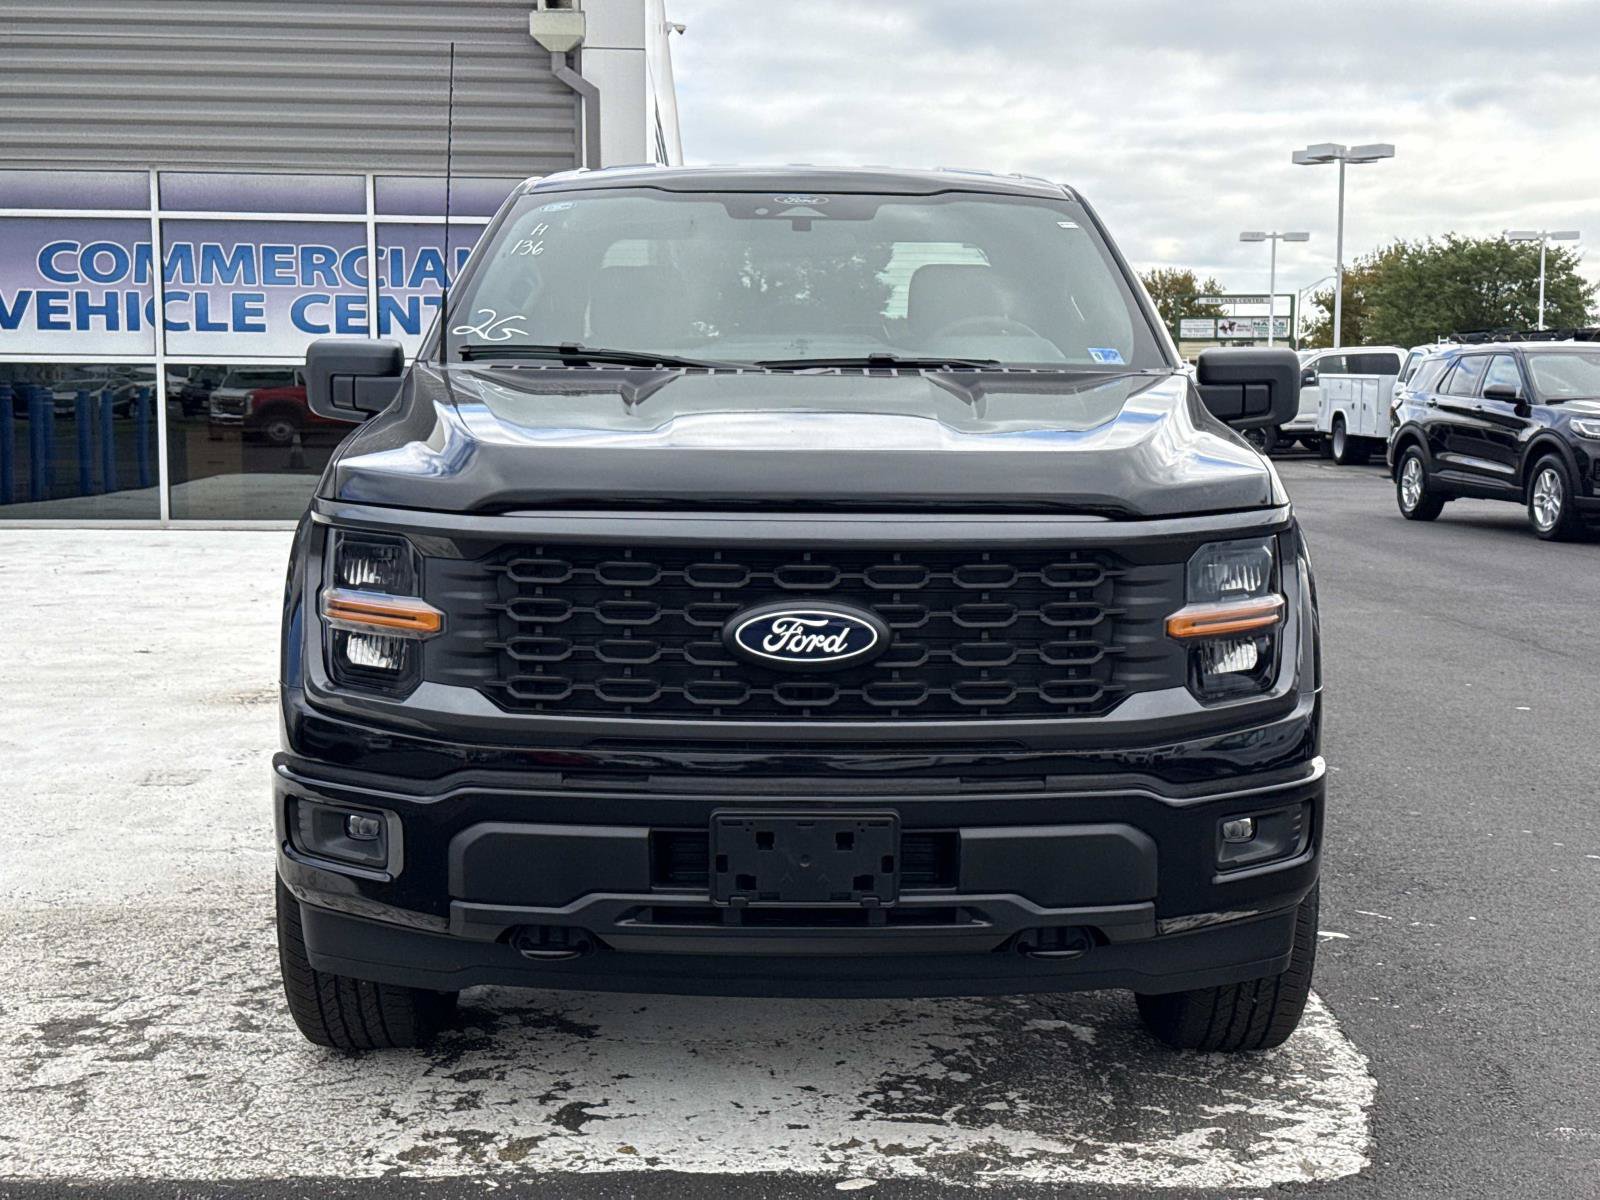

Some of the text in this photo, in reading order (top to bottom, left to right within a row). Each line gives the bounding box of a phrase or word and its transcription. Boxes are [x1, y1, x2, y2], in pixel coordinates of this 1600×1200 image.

[510, 239, 545, 256] 136
[0, 289, 268, 333] VEHICLE
[762, 617, 850, 653] Ford
